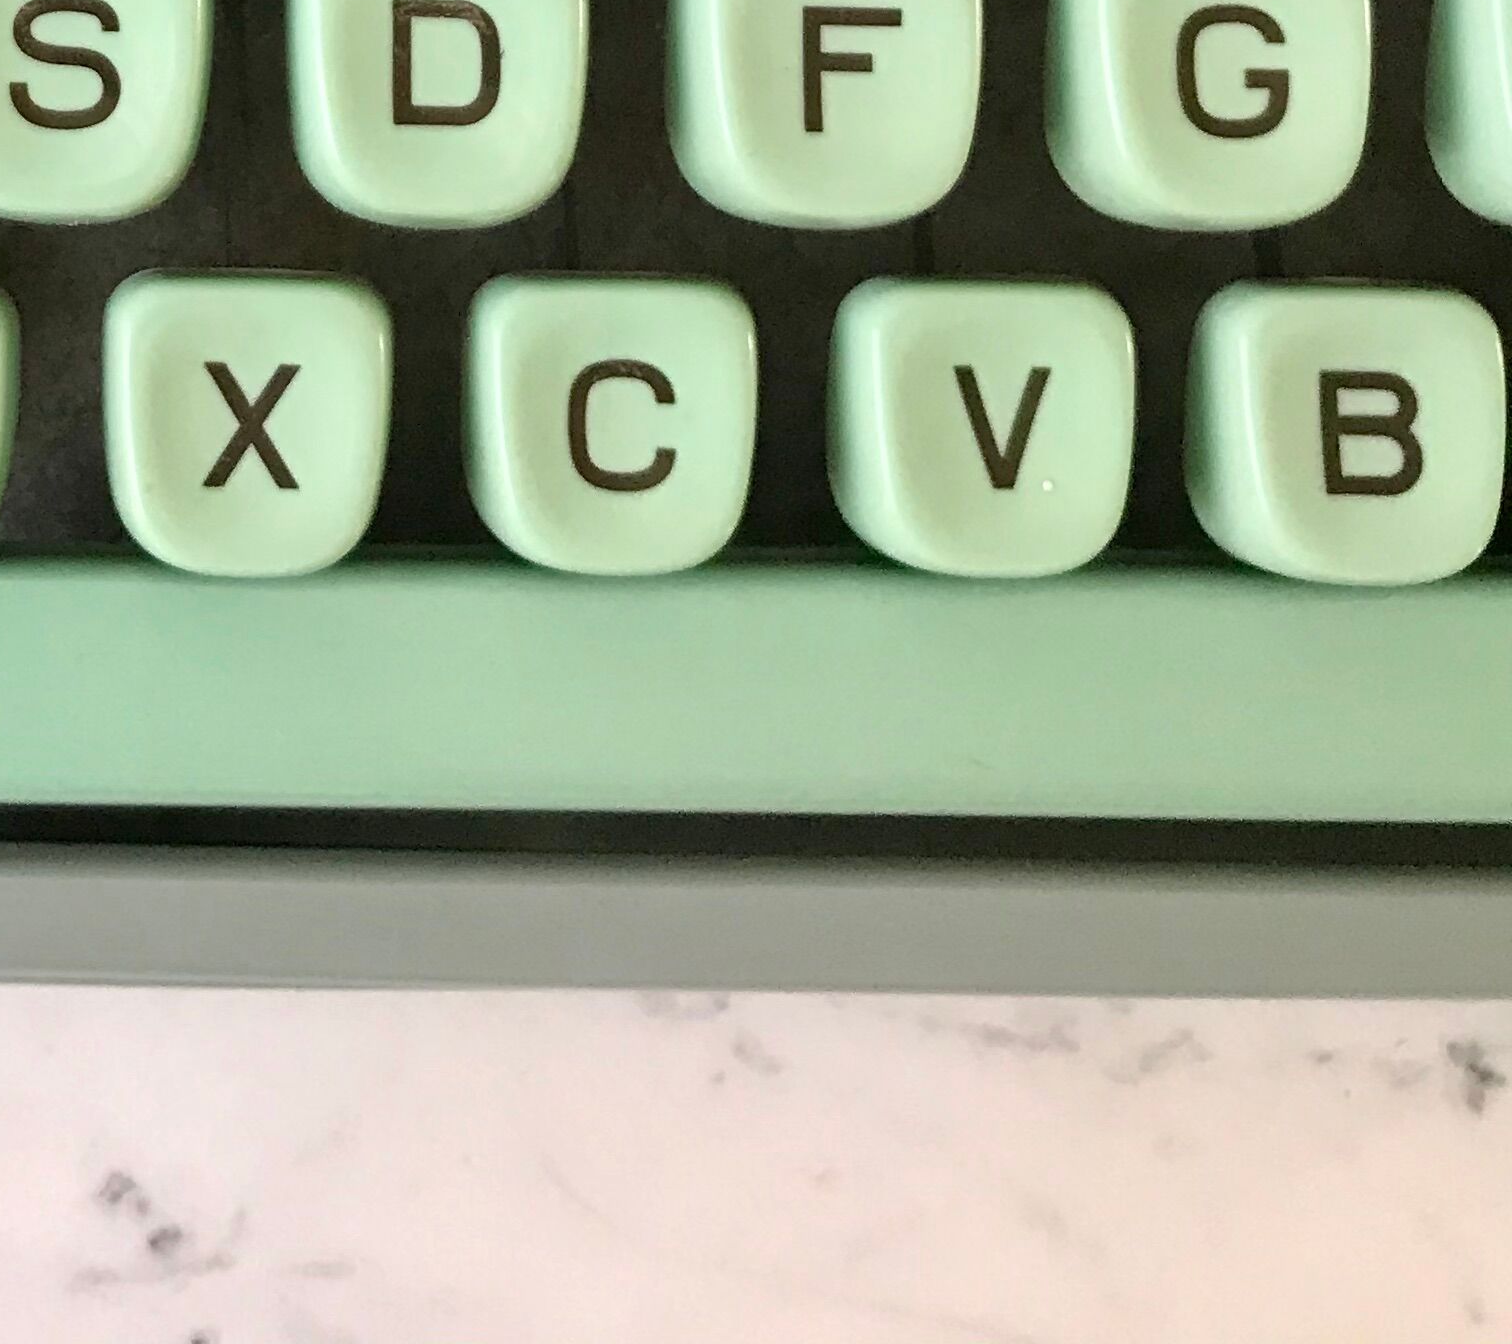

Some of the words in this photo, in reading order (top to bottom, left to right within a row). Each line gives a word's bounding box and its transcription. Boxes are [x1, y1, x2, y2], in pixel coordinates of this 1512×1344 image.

[803, 6, 902, 132] F
[1176, 5, 1289, 139] G
[203, 362, 300, 489] X
[568, 360, 676, 493] C
[954, 365, 1050, 490] V
[1319, 370, 1423, 497] B
